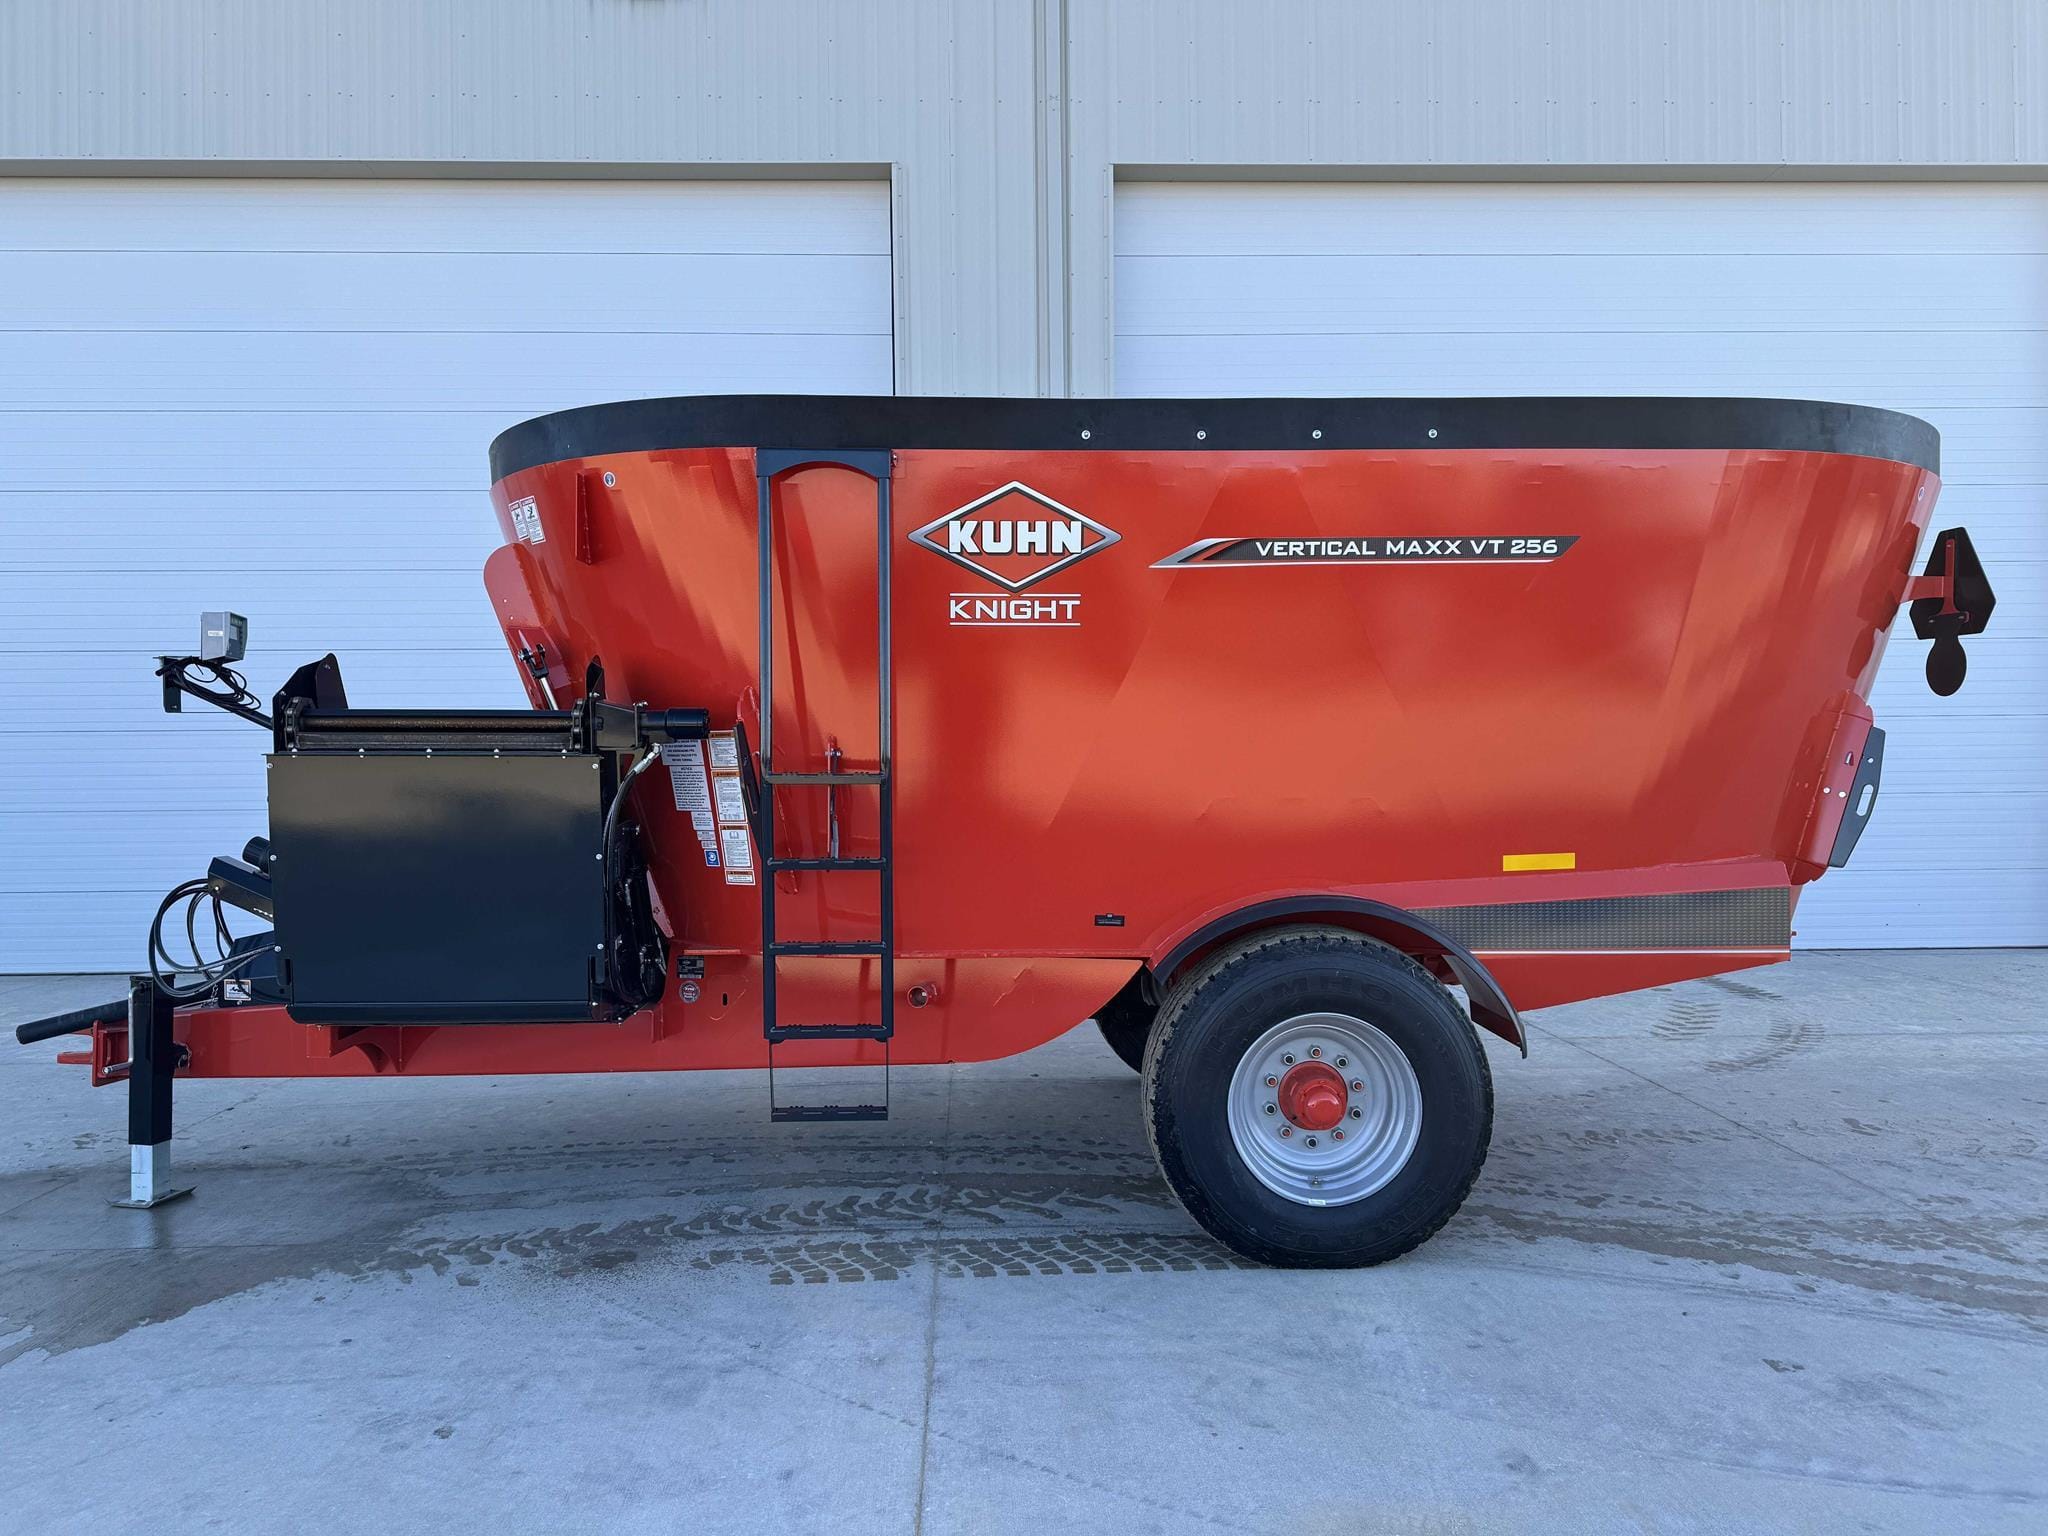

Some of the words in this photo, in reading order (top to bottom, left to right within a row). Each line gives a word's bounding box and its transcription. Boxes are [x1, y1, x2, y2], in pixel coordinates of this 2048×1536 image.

[948, 520, 1082, 554] KUHN
[1255, 541, 1376, 556] VERTICAL
[1386, 540, 1462, 555] MAXX
[1470, 540, 1505, 554] VT
[1510, 539, 1558, 554] 256
[950, 599, 1081, 620] KNIGHT
